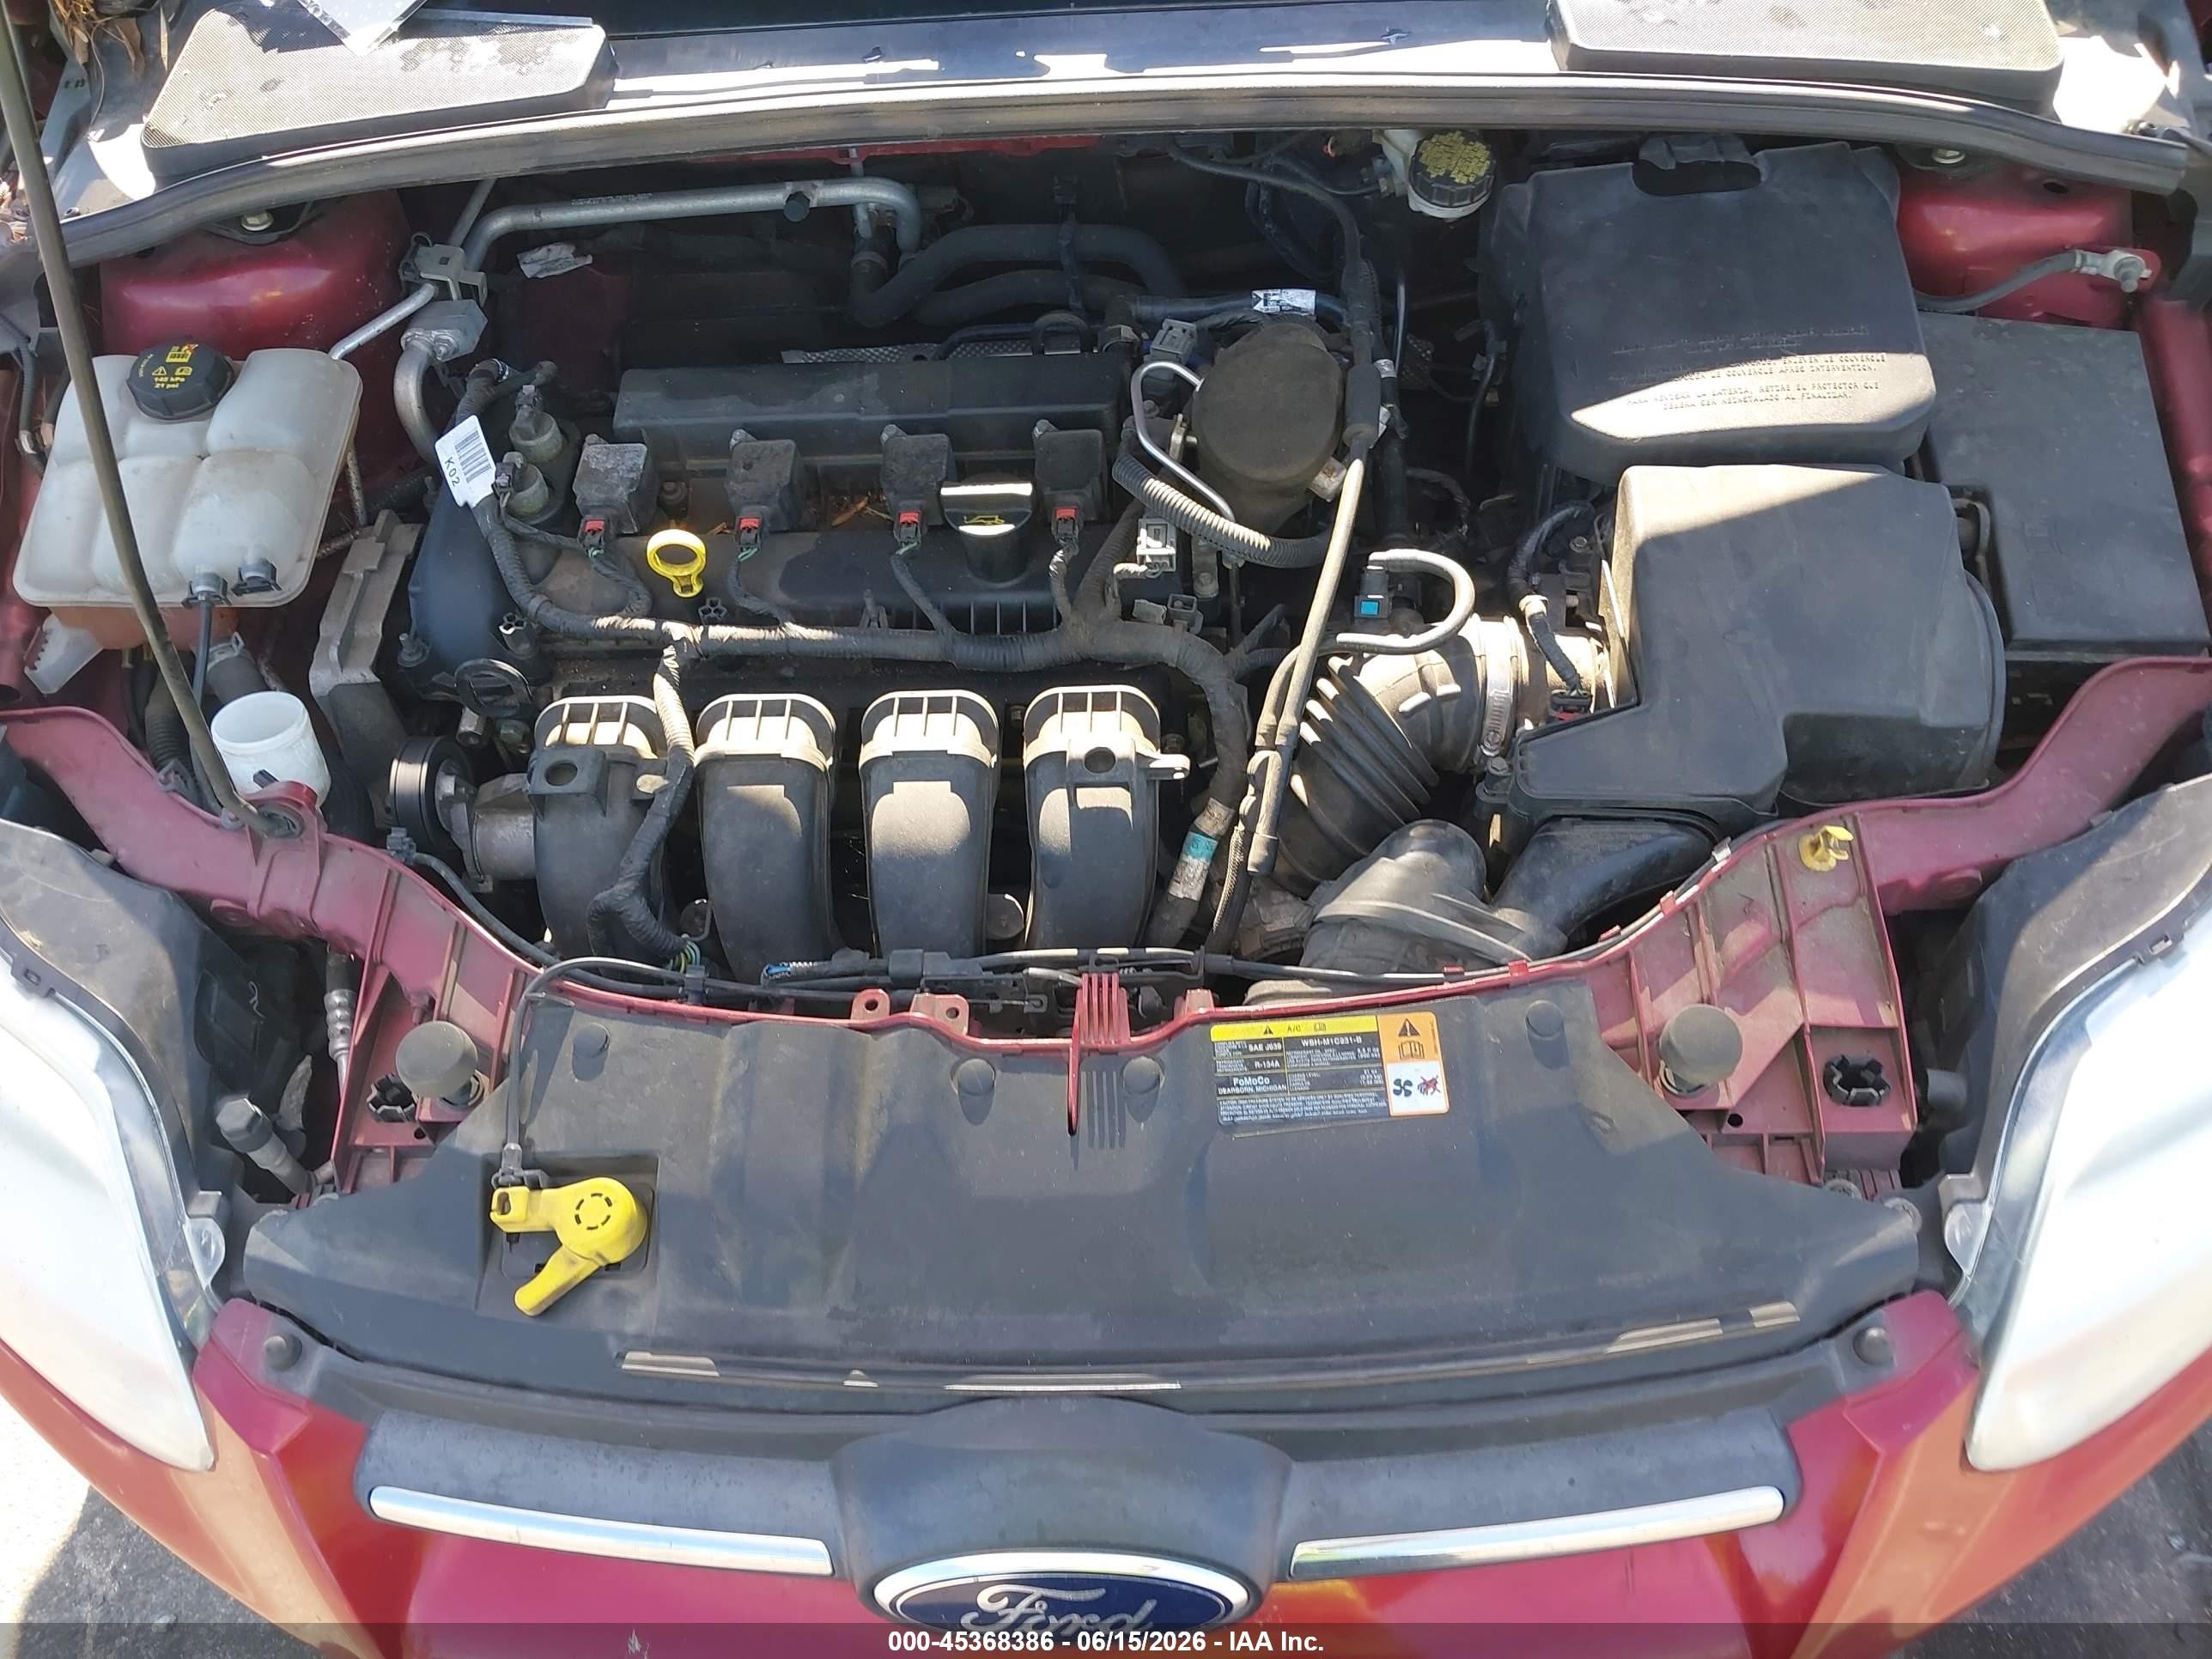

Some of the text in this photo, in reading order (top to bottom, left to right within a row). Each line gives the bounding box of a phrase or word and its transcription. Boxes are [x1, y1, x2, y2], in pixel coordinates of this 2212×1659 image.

[444, 456, 460, 487] K02
[1254, 1059, 1280, 1069] R-134A
[1232, 1075, 1271, 1087] FoMoCo
[1255, 1083, 1288, 1093] MICHIGAN
[960, 1583, 1158, 1637] Ford
